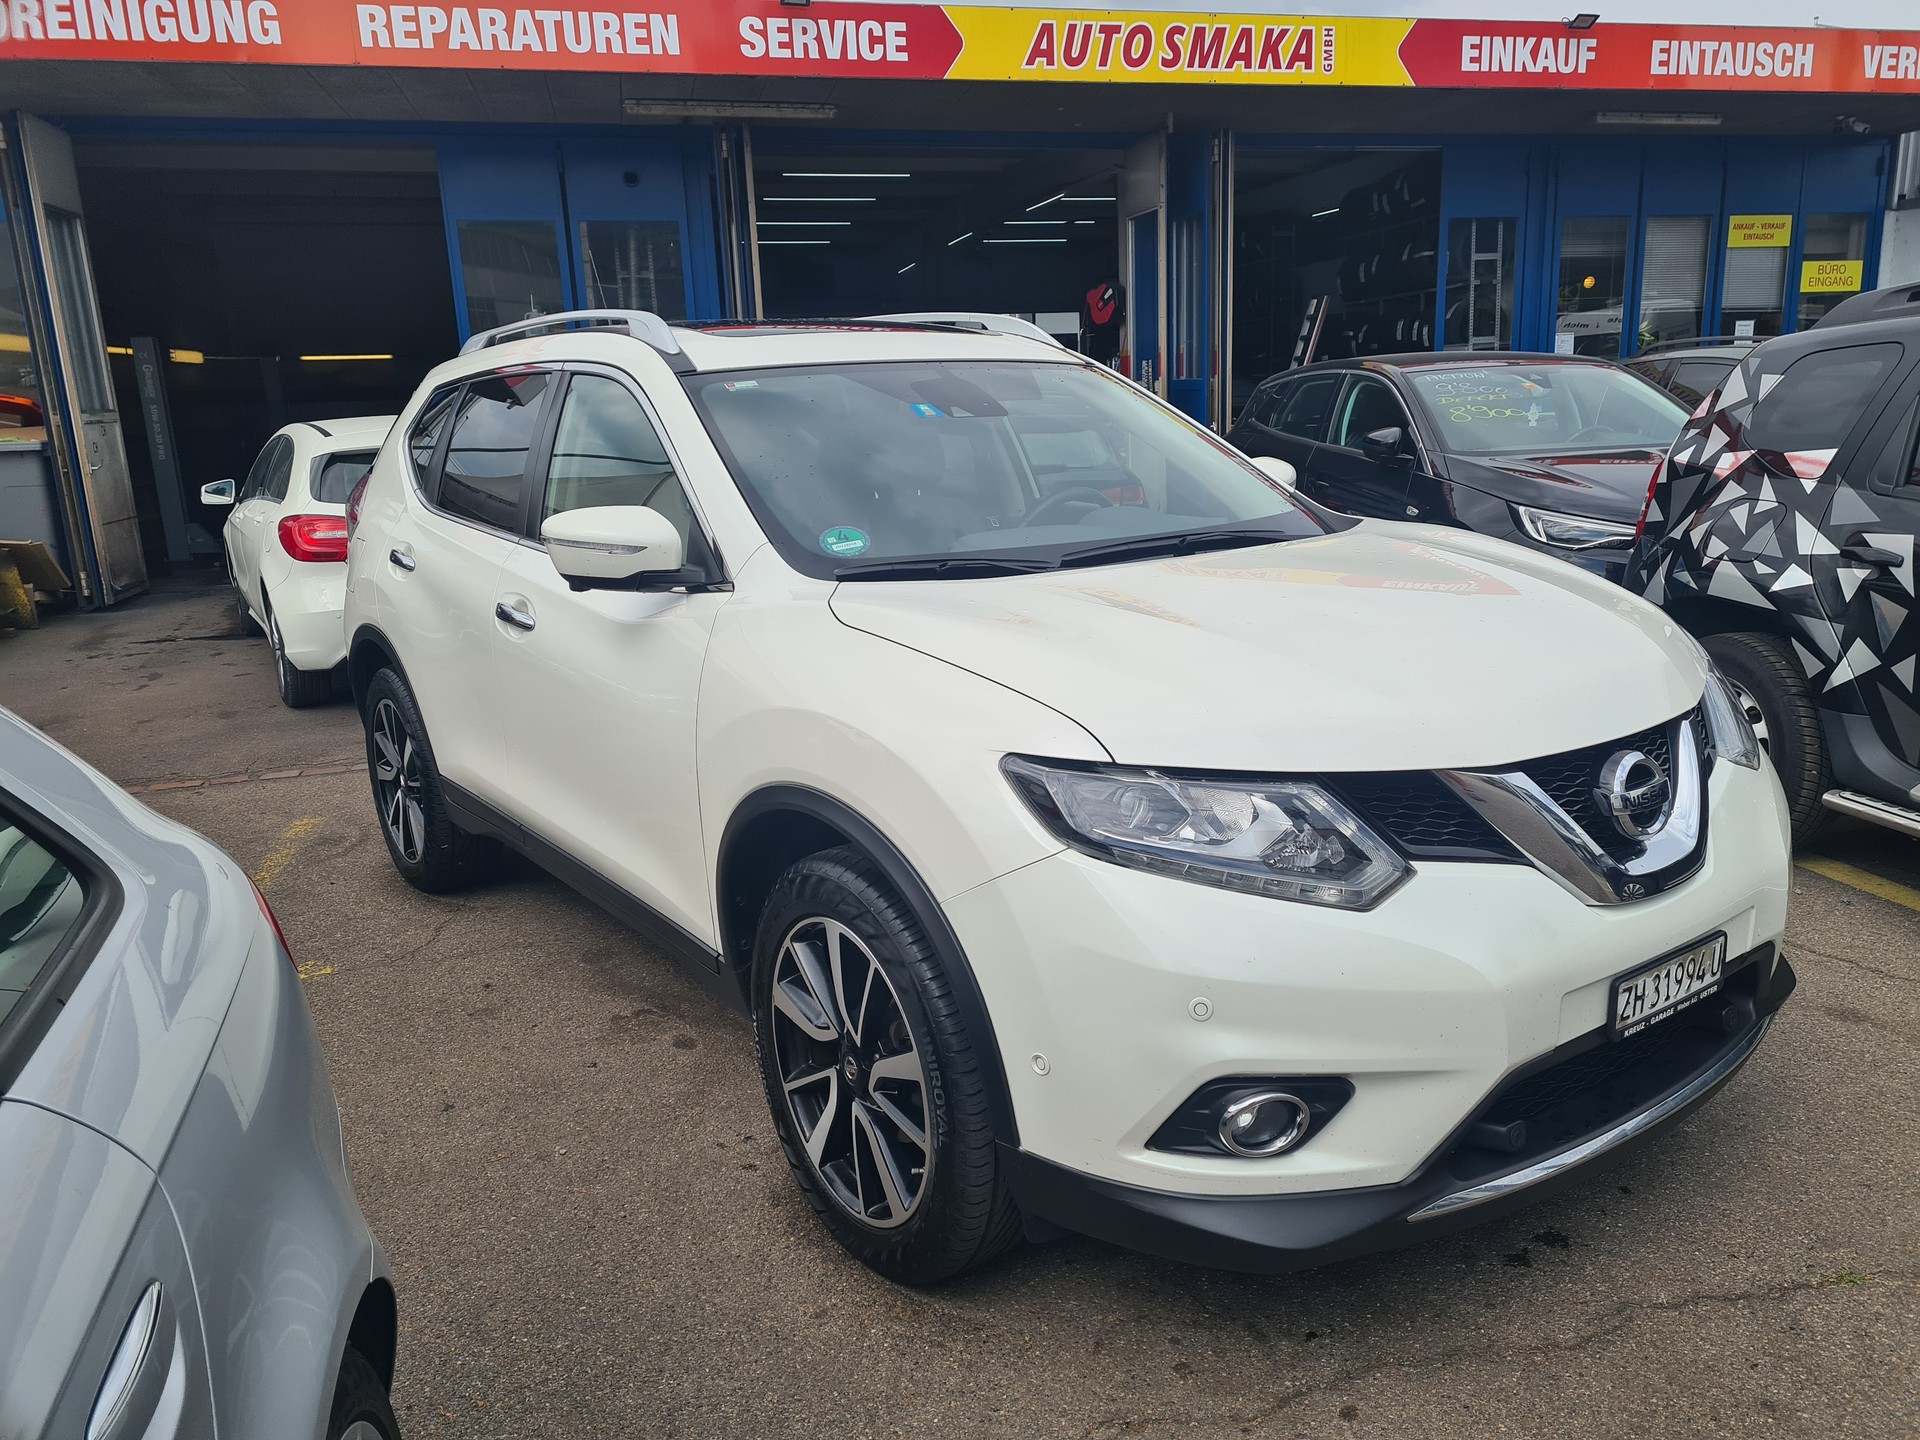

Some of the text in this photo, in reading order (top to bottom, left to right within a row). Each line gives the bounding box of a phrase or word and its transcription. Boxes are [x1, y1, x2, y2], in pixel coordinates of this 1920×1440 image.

[0, 0, 282, 45] REINIGUNG
[356, 4, 681, 55] REPARATUREN
[738, 16, 909, 62] SERVICE
[1022, 20, 1316, 73] AUTO SMAKA
[1321, 26, 1335, 74] GMBH
[1461, 35, 1598, 74] EINKAUF
[1650, 40, 1815, 78] EINTAUSCH
[1863, 44, 1920, 80] VER
[1732, 222, 1756, 231] ANKAUF
[1760, 222, 1787, 231] VERKAUF
[1743, 232, 1775, 241] EINTAUSCH
[1808, 275, 1854, 288] EINGANG
[1817, 262, 1847, 276] BÜRO
[1624, 1021, 1646, 1037] KREUZ
[1650, 1007, 1675, 1024] GARAGE
[1700, 985, 1718, 999] USTER
[919, 1027, 950, 1148] UNIROYAL
